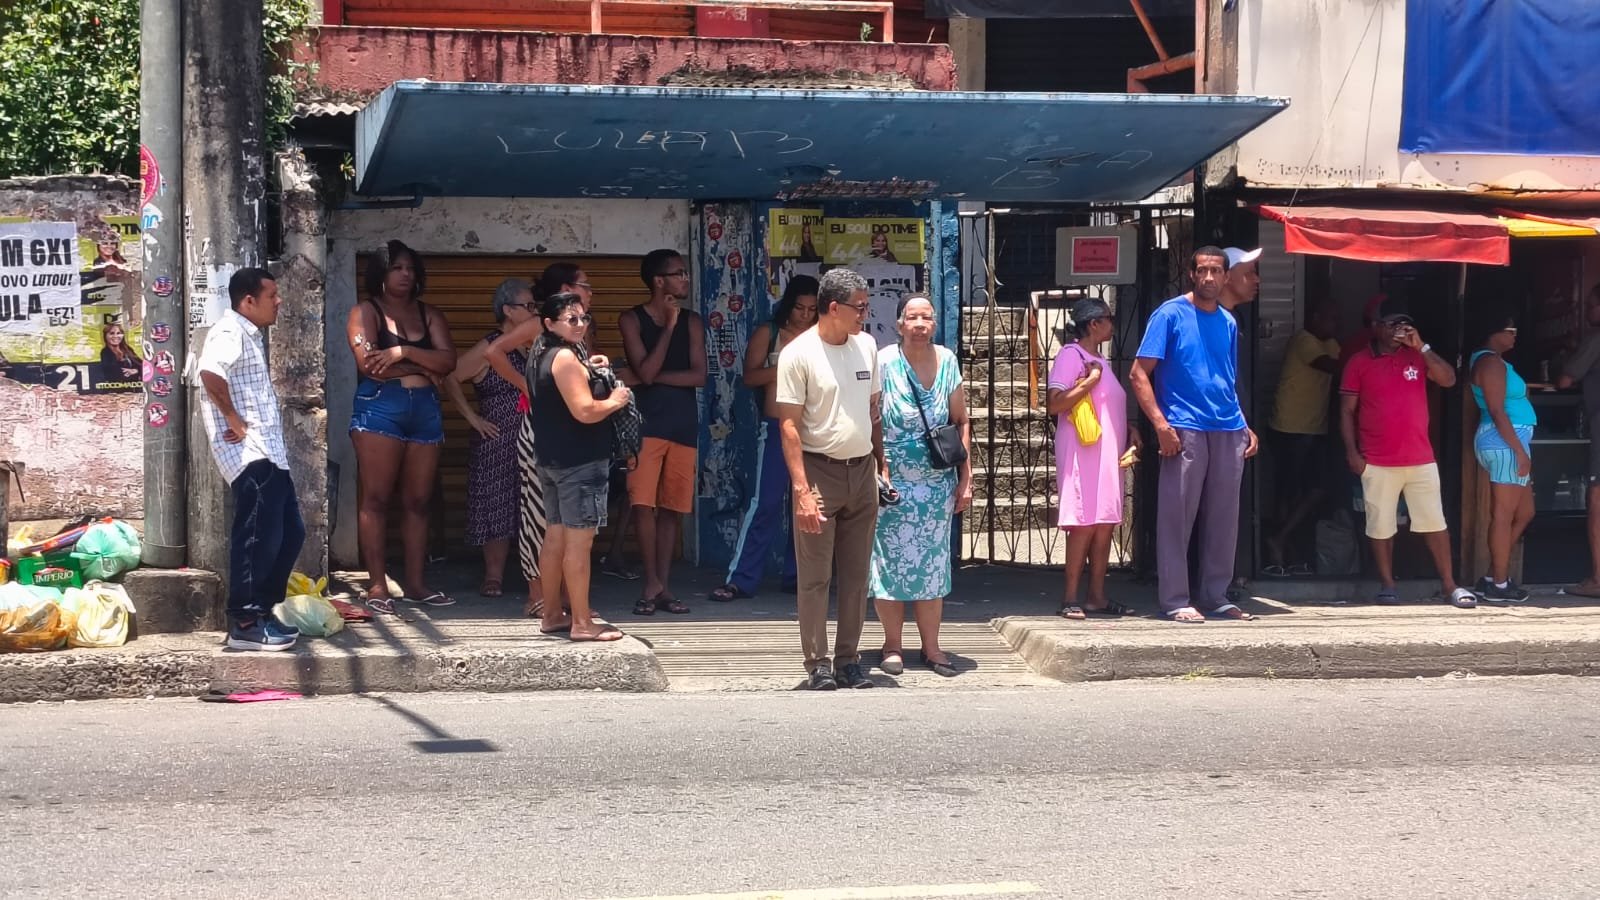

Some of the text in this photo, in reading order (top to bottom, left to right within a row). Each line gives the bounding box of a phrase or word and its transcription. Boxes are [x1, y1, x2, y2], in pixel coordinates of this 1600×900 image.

[831, 224, 917, 234] EU SOU DO TIME
[30, 238, 72, 266] 6X1
[32, 273, 73, 287] LUTOU!
[55, 364, 90, 391] 21
